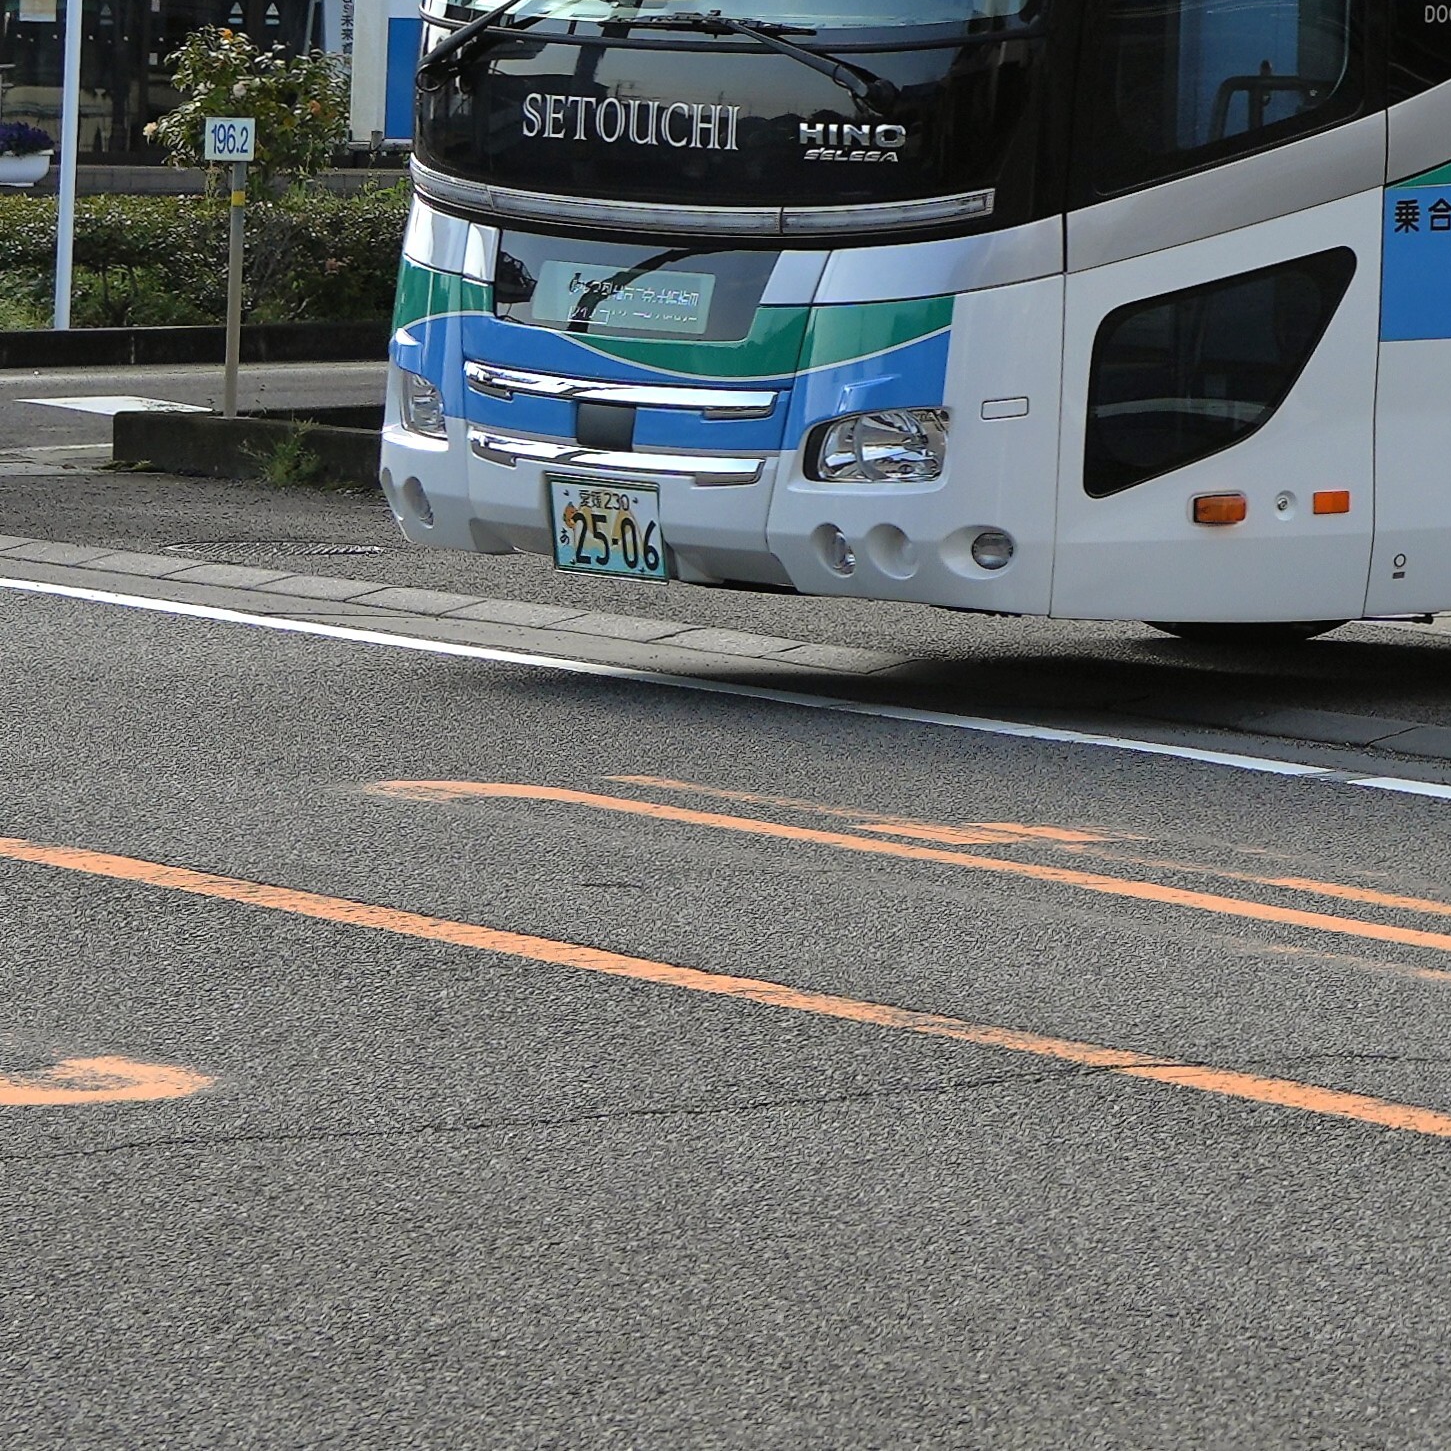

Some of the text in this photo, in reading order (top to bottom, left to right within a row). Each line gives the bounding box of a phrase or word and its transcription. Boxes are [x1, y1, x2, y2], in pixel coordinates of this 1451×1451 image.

[211, 123, 249, 155] 196.2
[522, 92, 741, 151] SETOUCHI
[800, 123, 907, 148] HINO
[571, 512, 660, 571] 25-06
